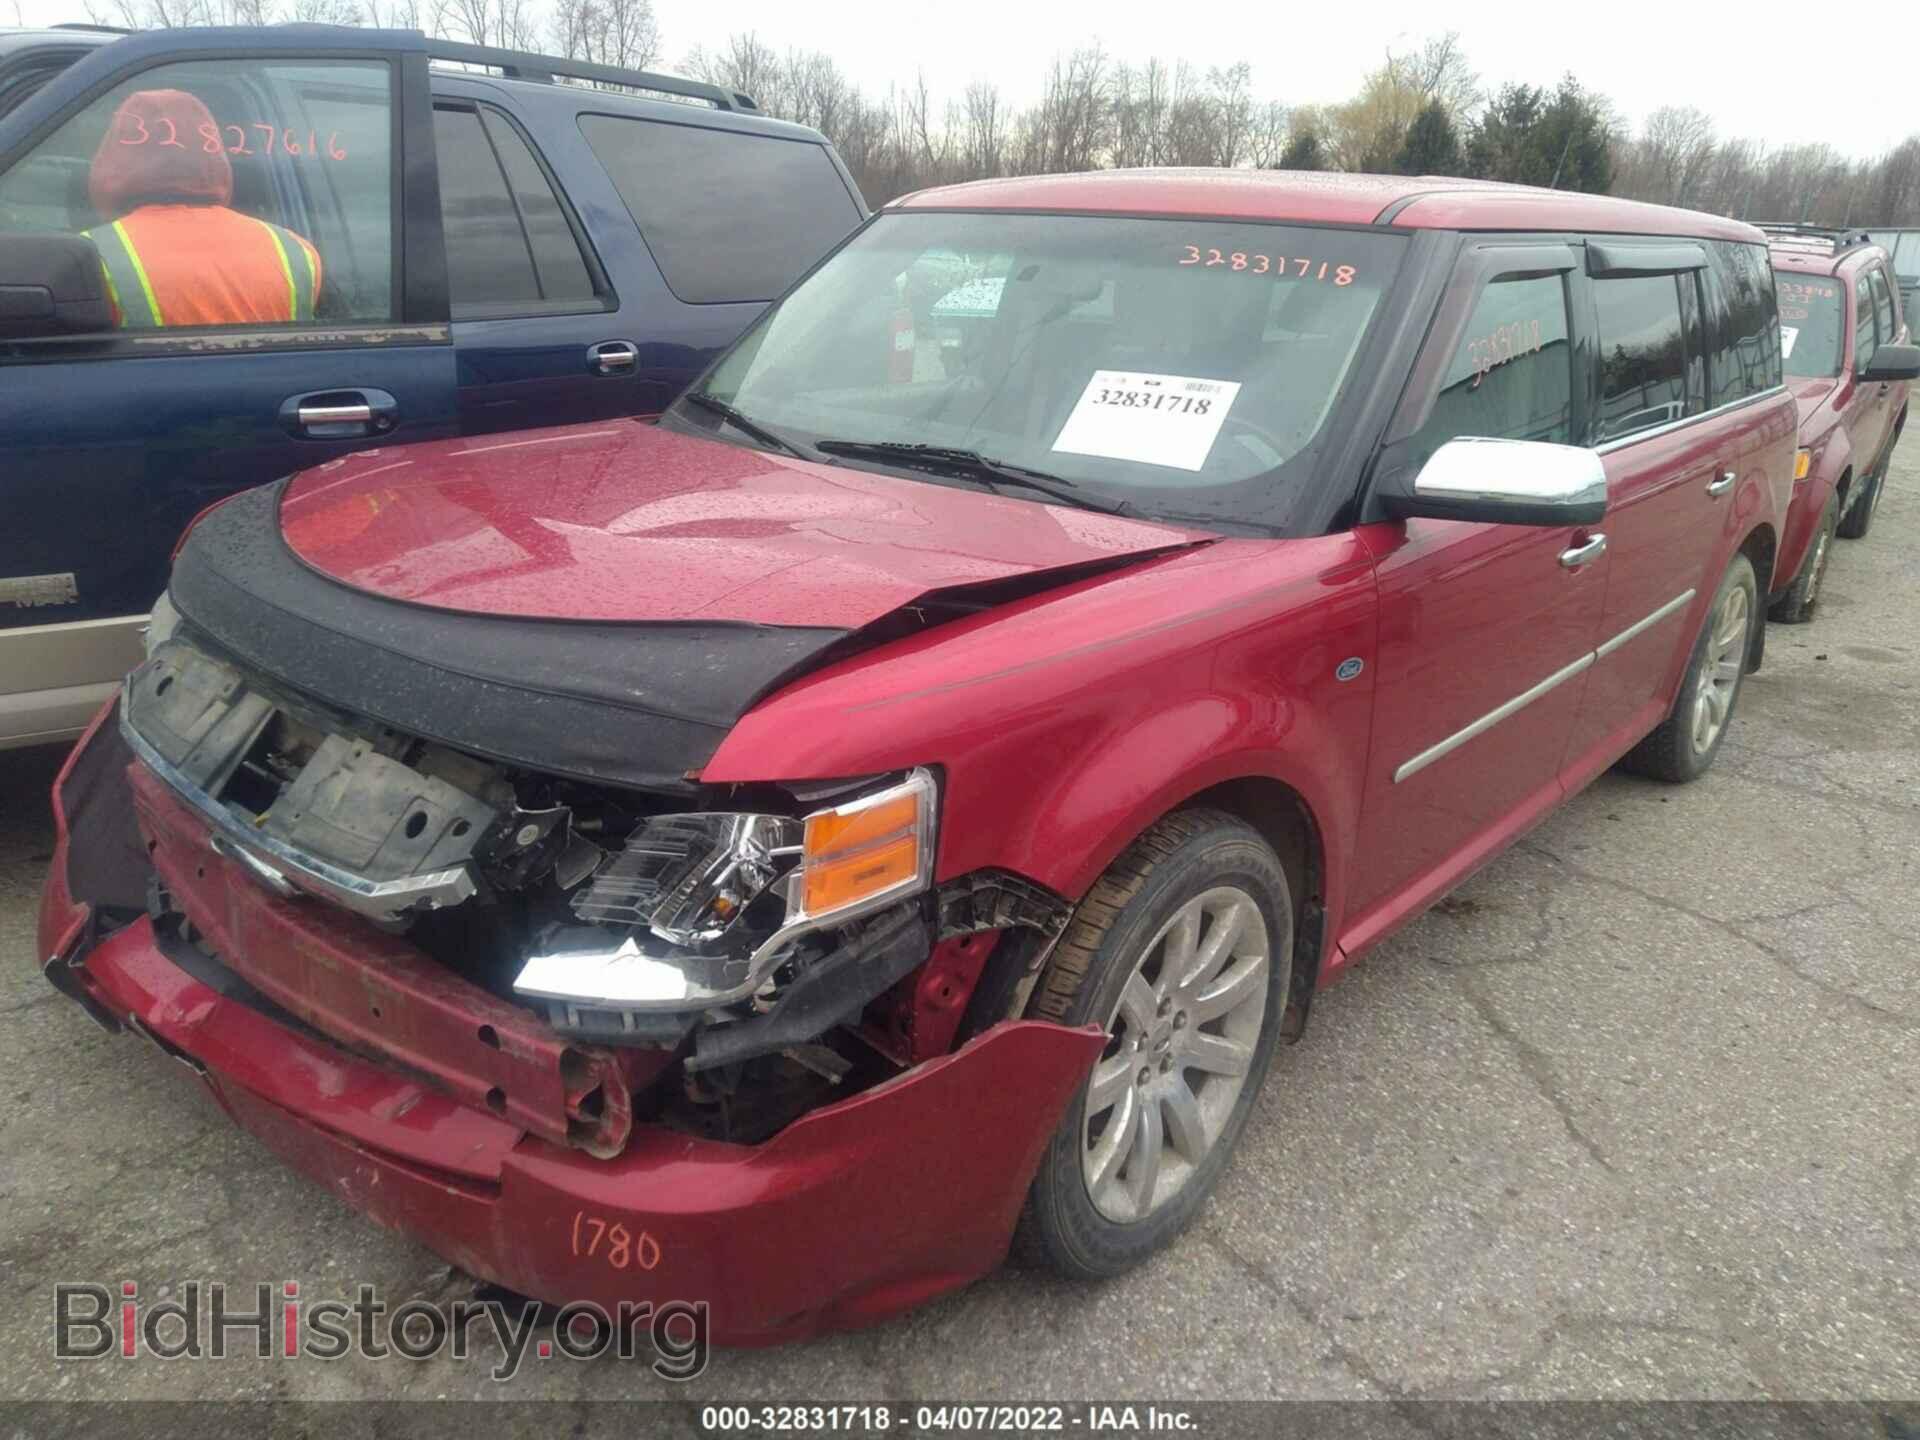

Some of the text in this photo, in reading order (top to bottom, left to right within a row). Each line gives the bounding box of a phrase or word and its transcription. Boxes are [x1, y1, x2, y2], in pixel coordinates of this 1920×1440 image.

[119, 112, 347, 160] 32827616
[1180, 245, 1356, 285] 32831718
[1092, 389, 1212, 415] 32831718
[573, 1212, 661, 1270] 1780
